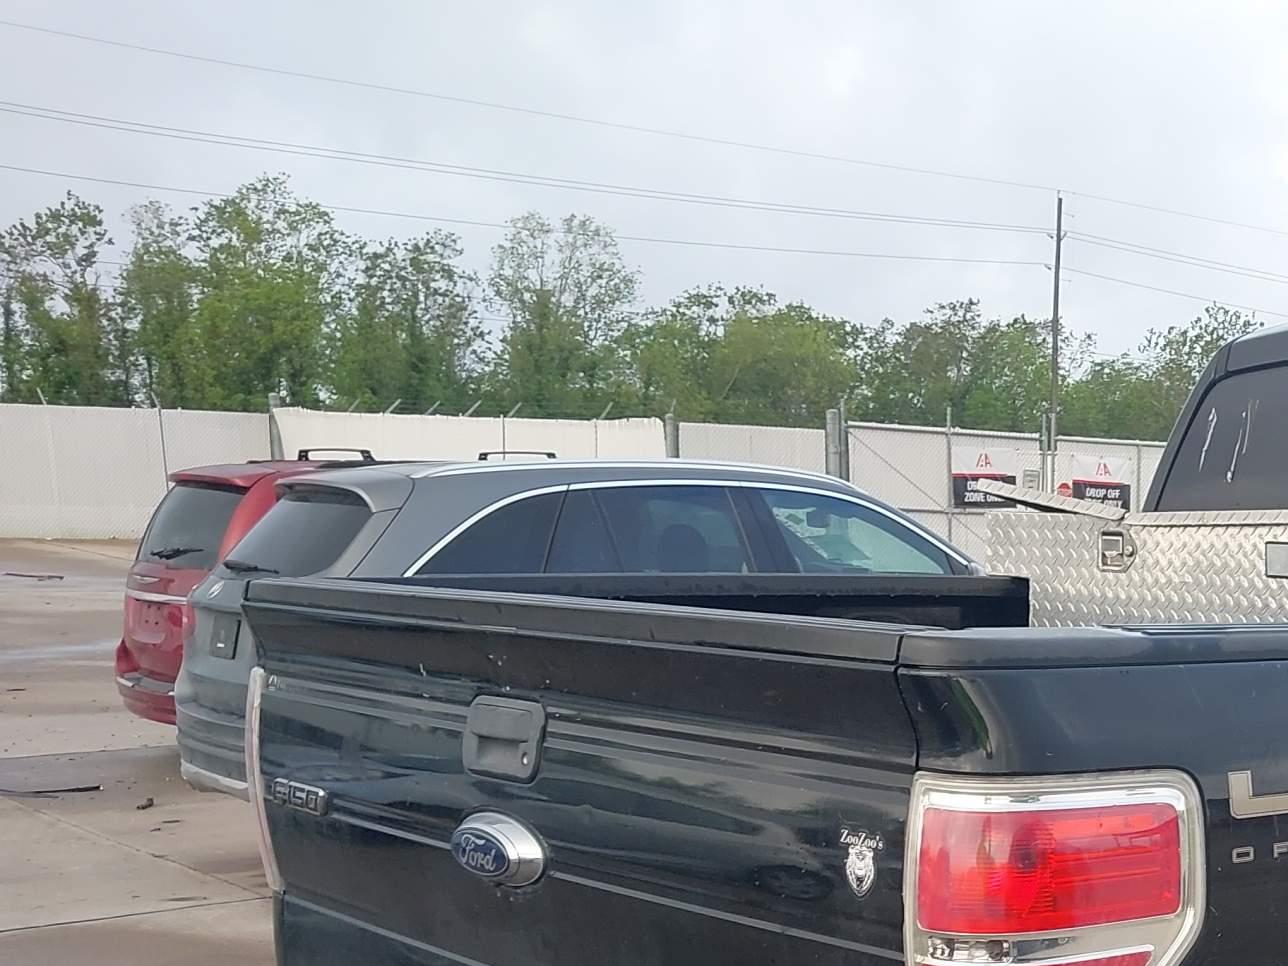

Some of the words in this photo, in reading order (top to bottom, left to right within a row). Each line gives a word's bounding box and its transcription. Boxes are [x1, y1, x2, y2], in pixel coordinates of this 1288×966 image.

[964, 492, 985, 503] ZONE
[1086, 487, 1106, 498] DROP
[1107, 489, 1121, 499] OFF
[460, 834, 496, 871] Ford
